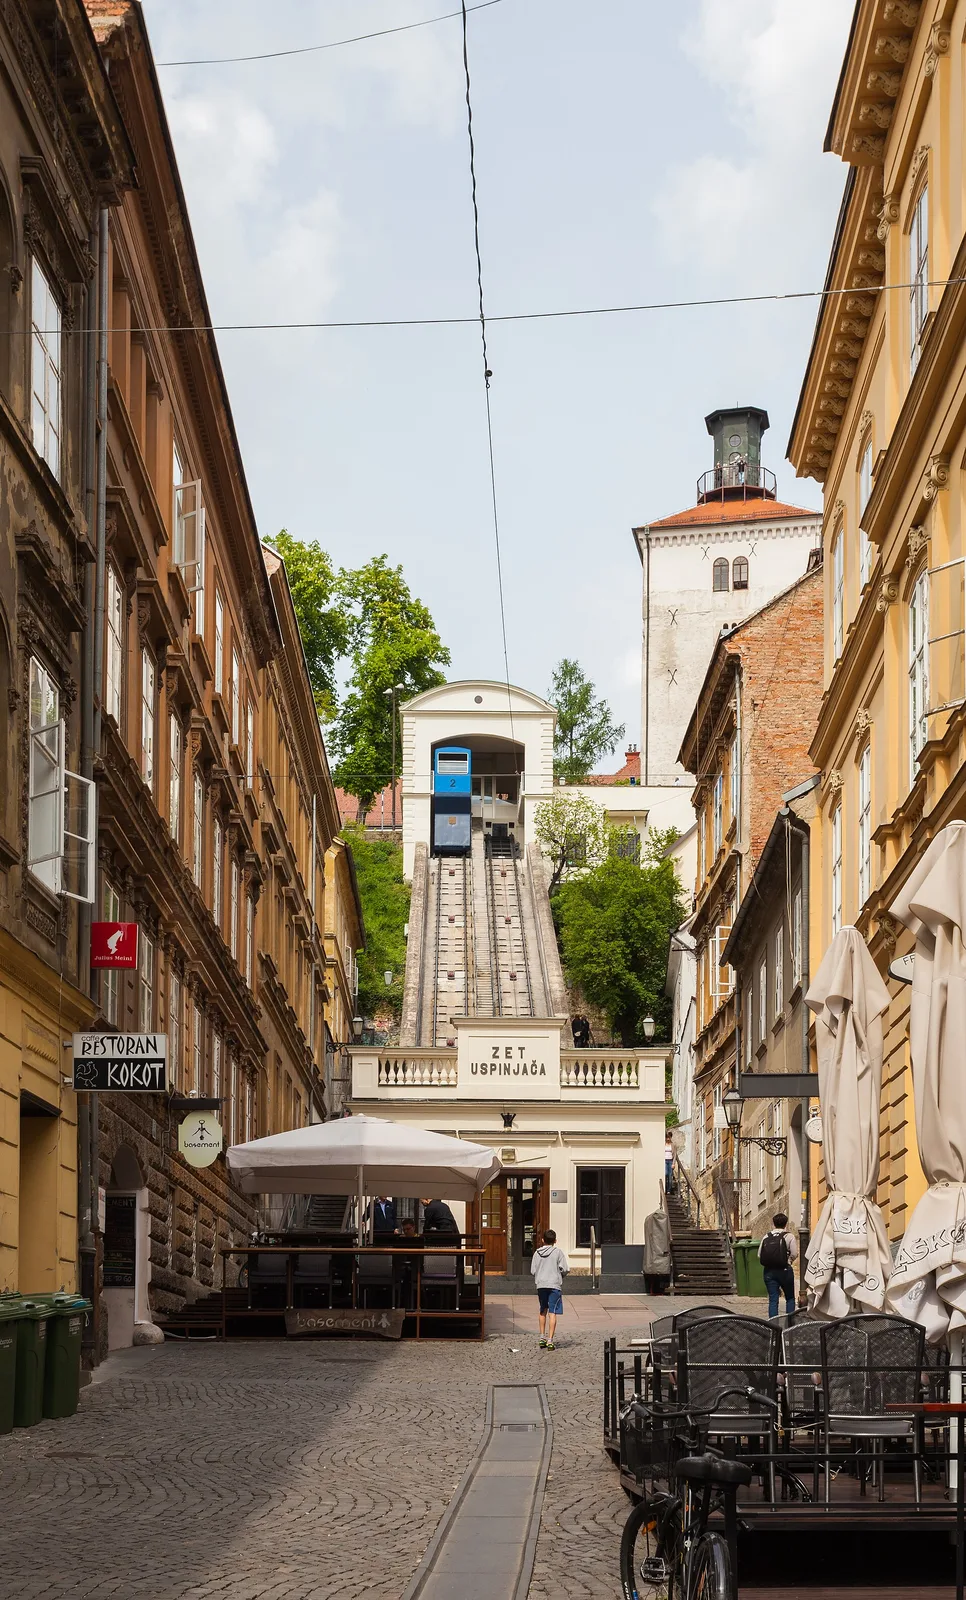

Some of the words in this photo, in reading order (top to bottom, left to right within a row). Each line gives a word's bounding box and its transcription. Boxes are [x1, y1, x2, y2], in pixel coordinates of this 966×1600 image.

[449, 778, 456, 788] 2
[81, 1035, 159, 1056] RESTORAN
[491, 1046, 526, 1059] ZET
[107, 1062, 164, 1088] KOKOT
[470, 1060, 547, 1076] USPINJAČA
[296, 1312, 376, 1328] basement
